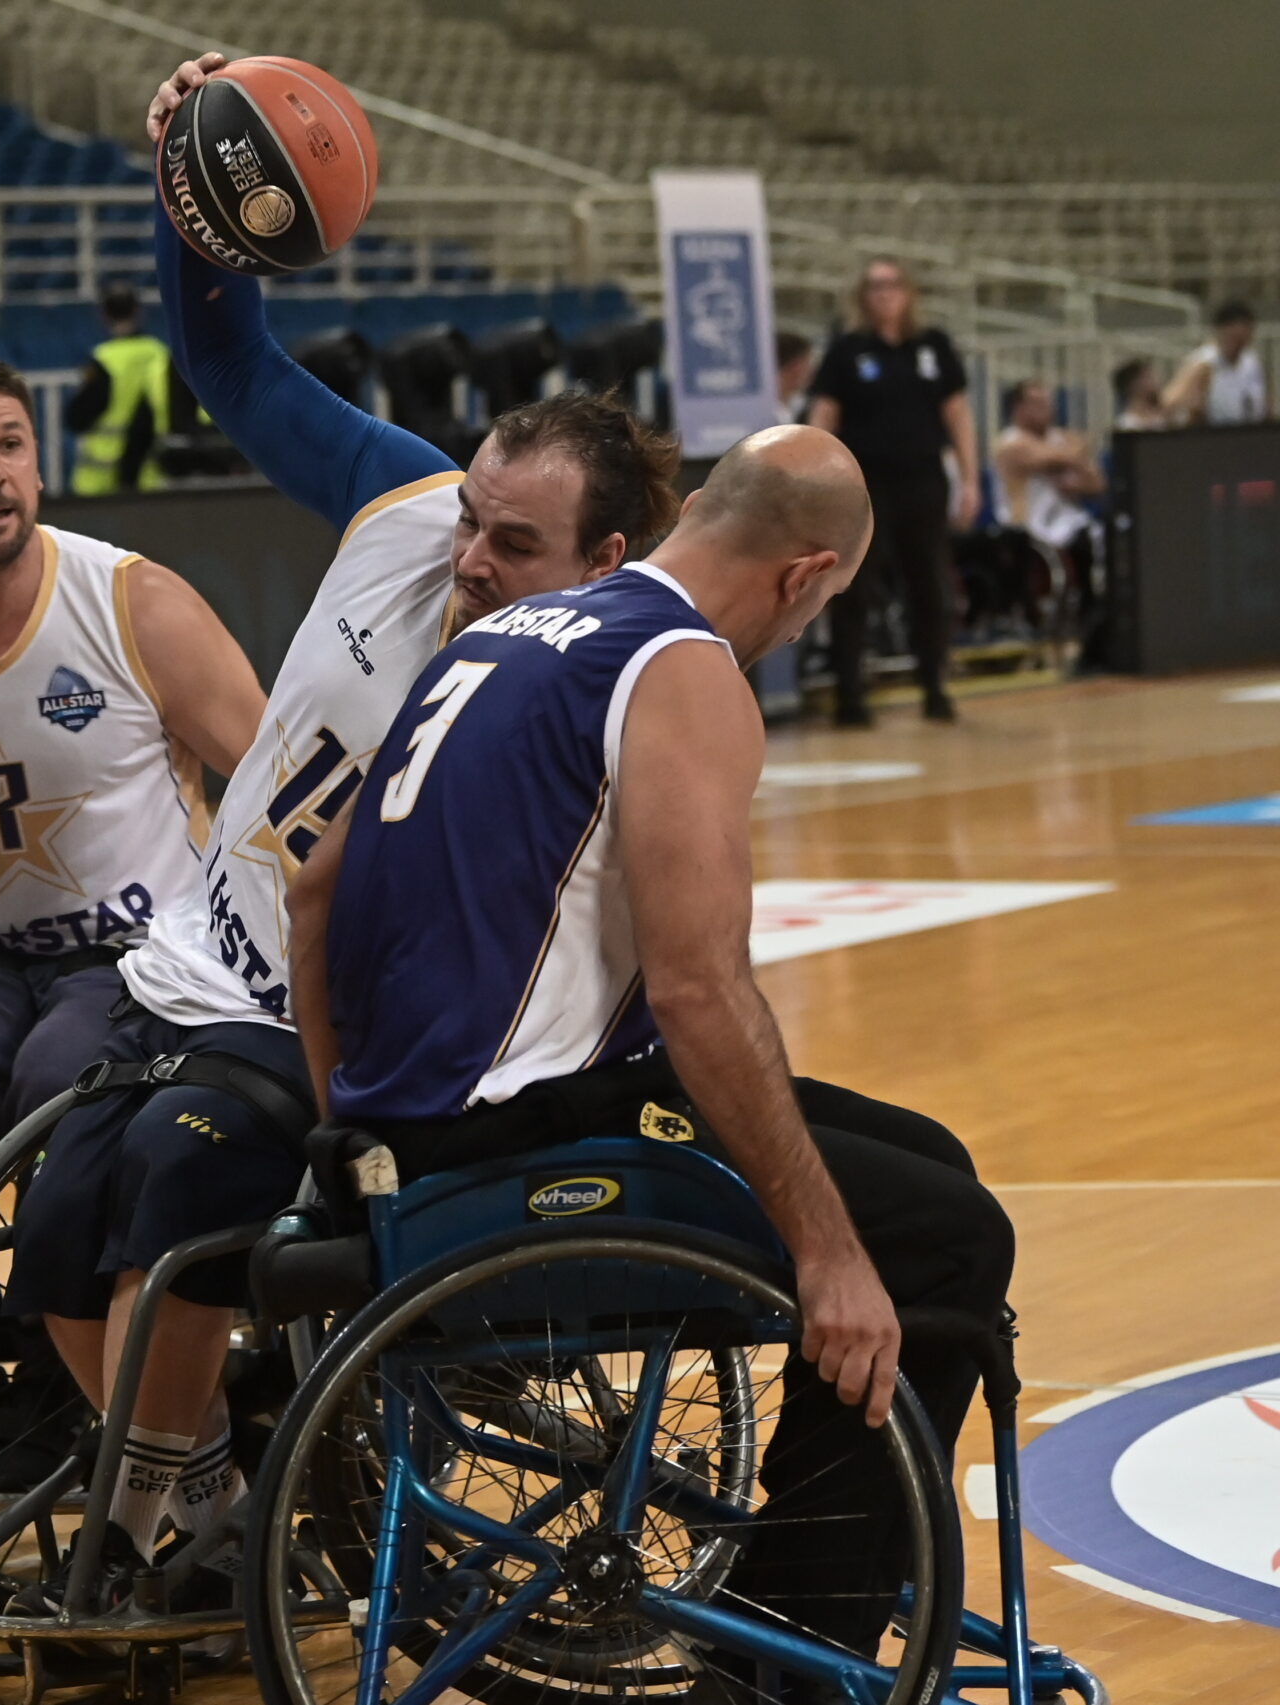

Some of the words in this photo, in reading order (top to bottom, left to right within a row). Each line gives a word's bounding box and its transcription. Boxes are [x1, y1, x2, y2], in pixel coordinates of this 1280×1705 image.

[233, 137, 264, 187] HEBA
[167, 128, 259, 268] SPALDING
[337, 617, 375, 676] athlos
[380, 659, 498, 823] 3
[533, 1187, 603, 1205] wheel
[127, 1477, 172, 1496] OFF
[129, 1463, 178, 1483] FUC
[181, 1466, 234, 1495] FUC
[185, 1479, 234, 1505] OFF
